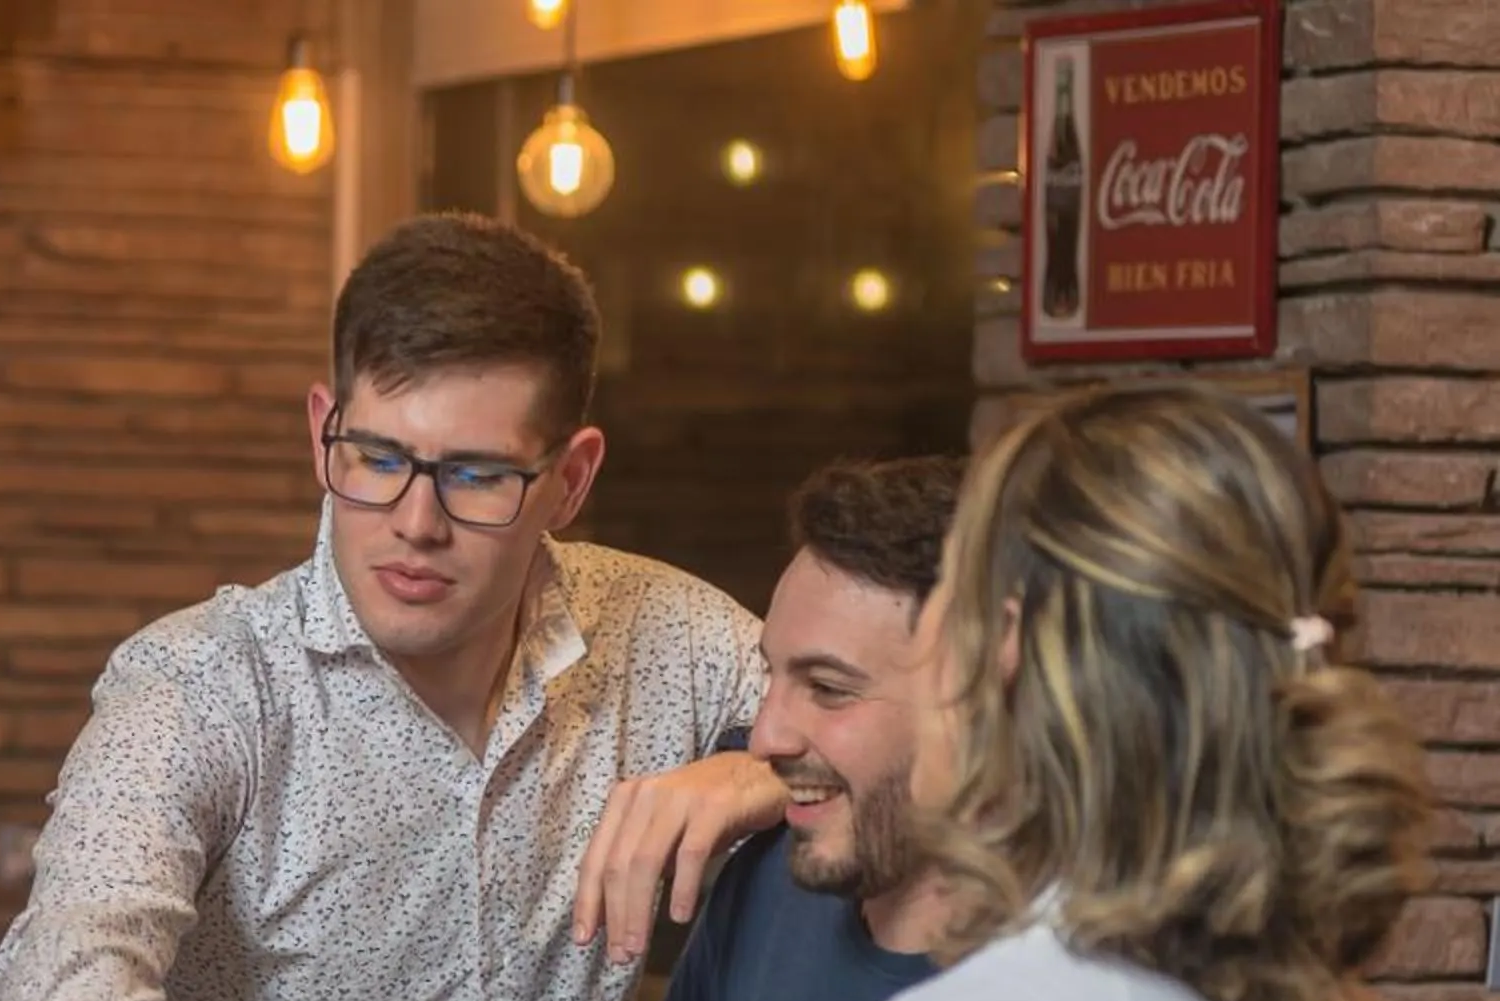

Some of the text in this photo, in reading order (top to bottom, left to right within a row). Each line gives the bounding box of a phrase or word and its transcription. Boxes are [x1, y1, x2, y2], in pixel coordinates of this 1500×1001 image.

[1105, 64, 1248, 104] VENDEMOS
[1108, 257, 1236, 292] BIEN FRIA
